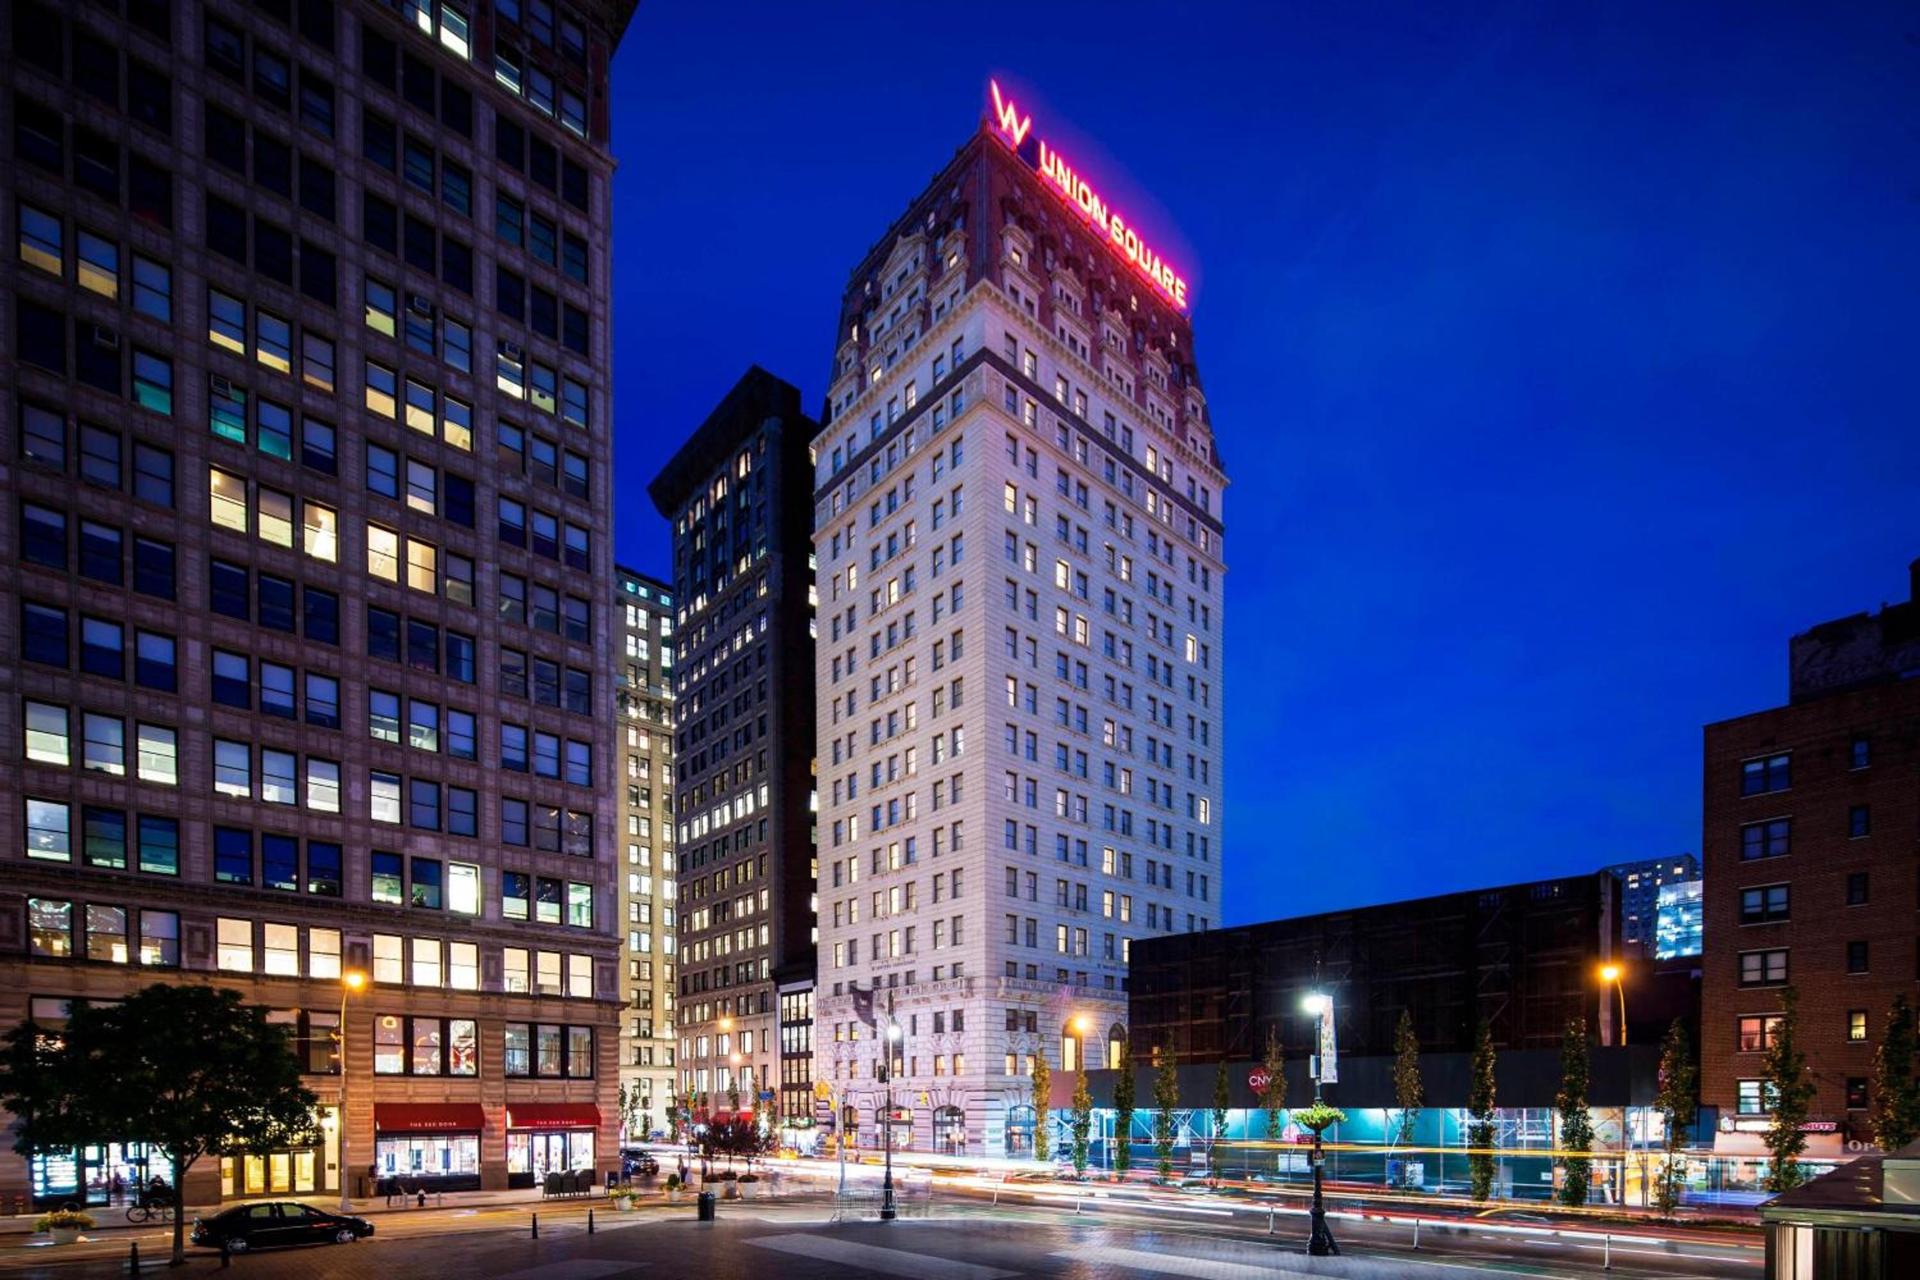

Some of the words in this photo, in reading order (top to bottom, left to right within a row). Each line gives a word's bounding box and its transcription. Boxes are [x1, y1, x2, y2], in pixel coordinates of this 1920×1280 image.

[991, 79, 1031, 145] W
[1040, 140, 1108, 230] UNION
[1111, 214, 1188, 308] SQUARE
